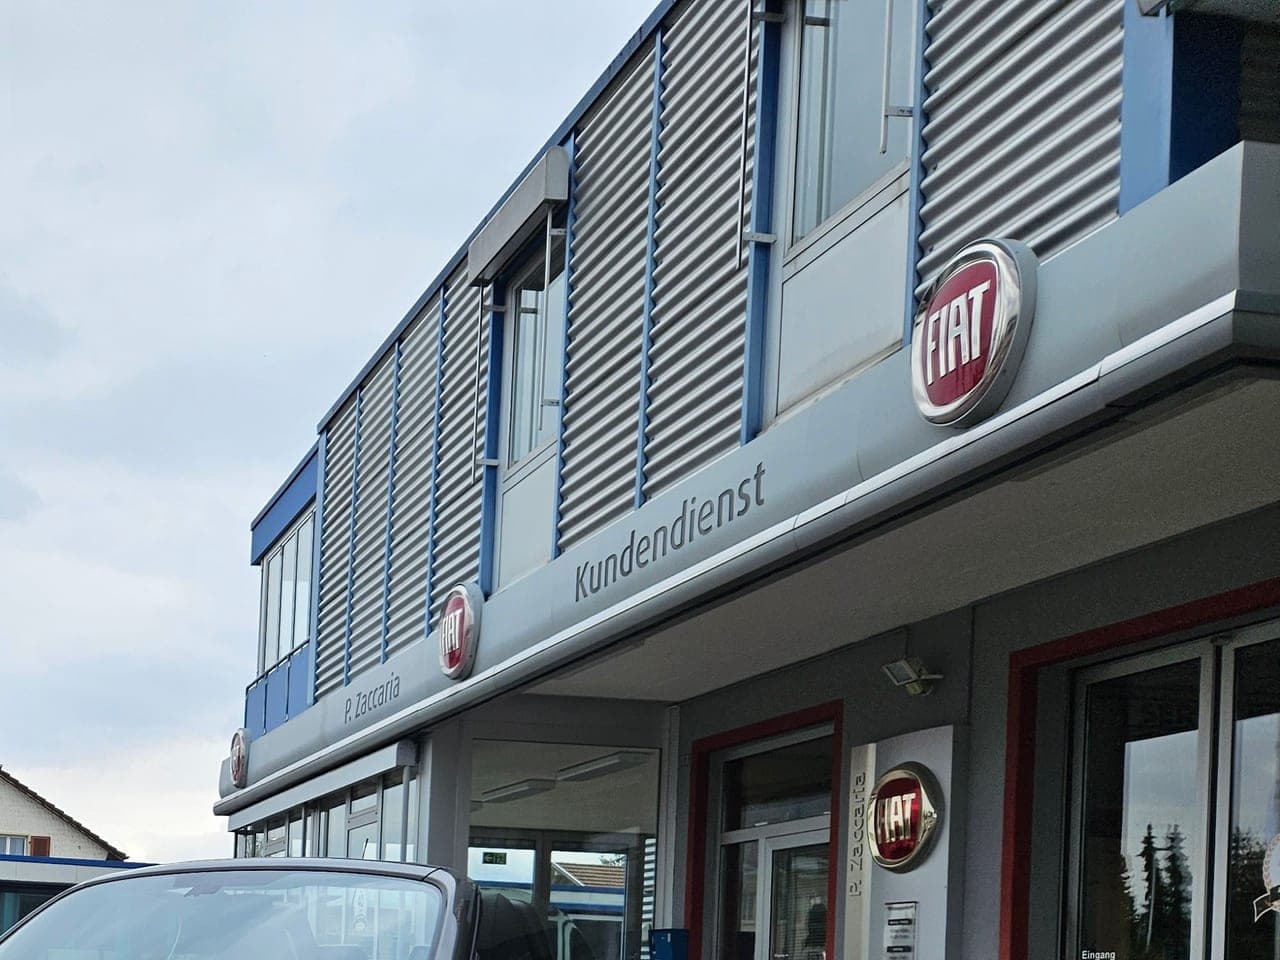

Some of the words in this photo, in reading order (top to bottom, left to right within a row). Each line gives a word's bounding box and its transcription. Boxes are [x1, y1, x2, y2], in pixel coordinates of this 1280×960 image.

[926, 280, 991, 387] FIAT
[575, 460, 766, 602] Kundendienst
[441, 608, 463, 656] FIAT
[344, 698, 352, 724] P.
[354, 672, 401, 719] Zaccaria
